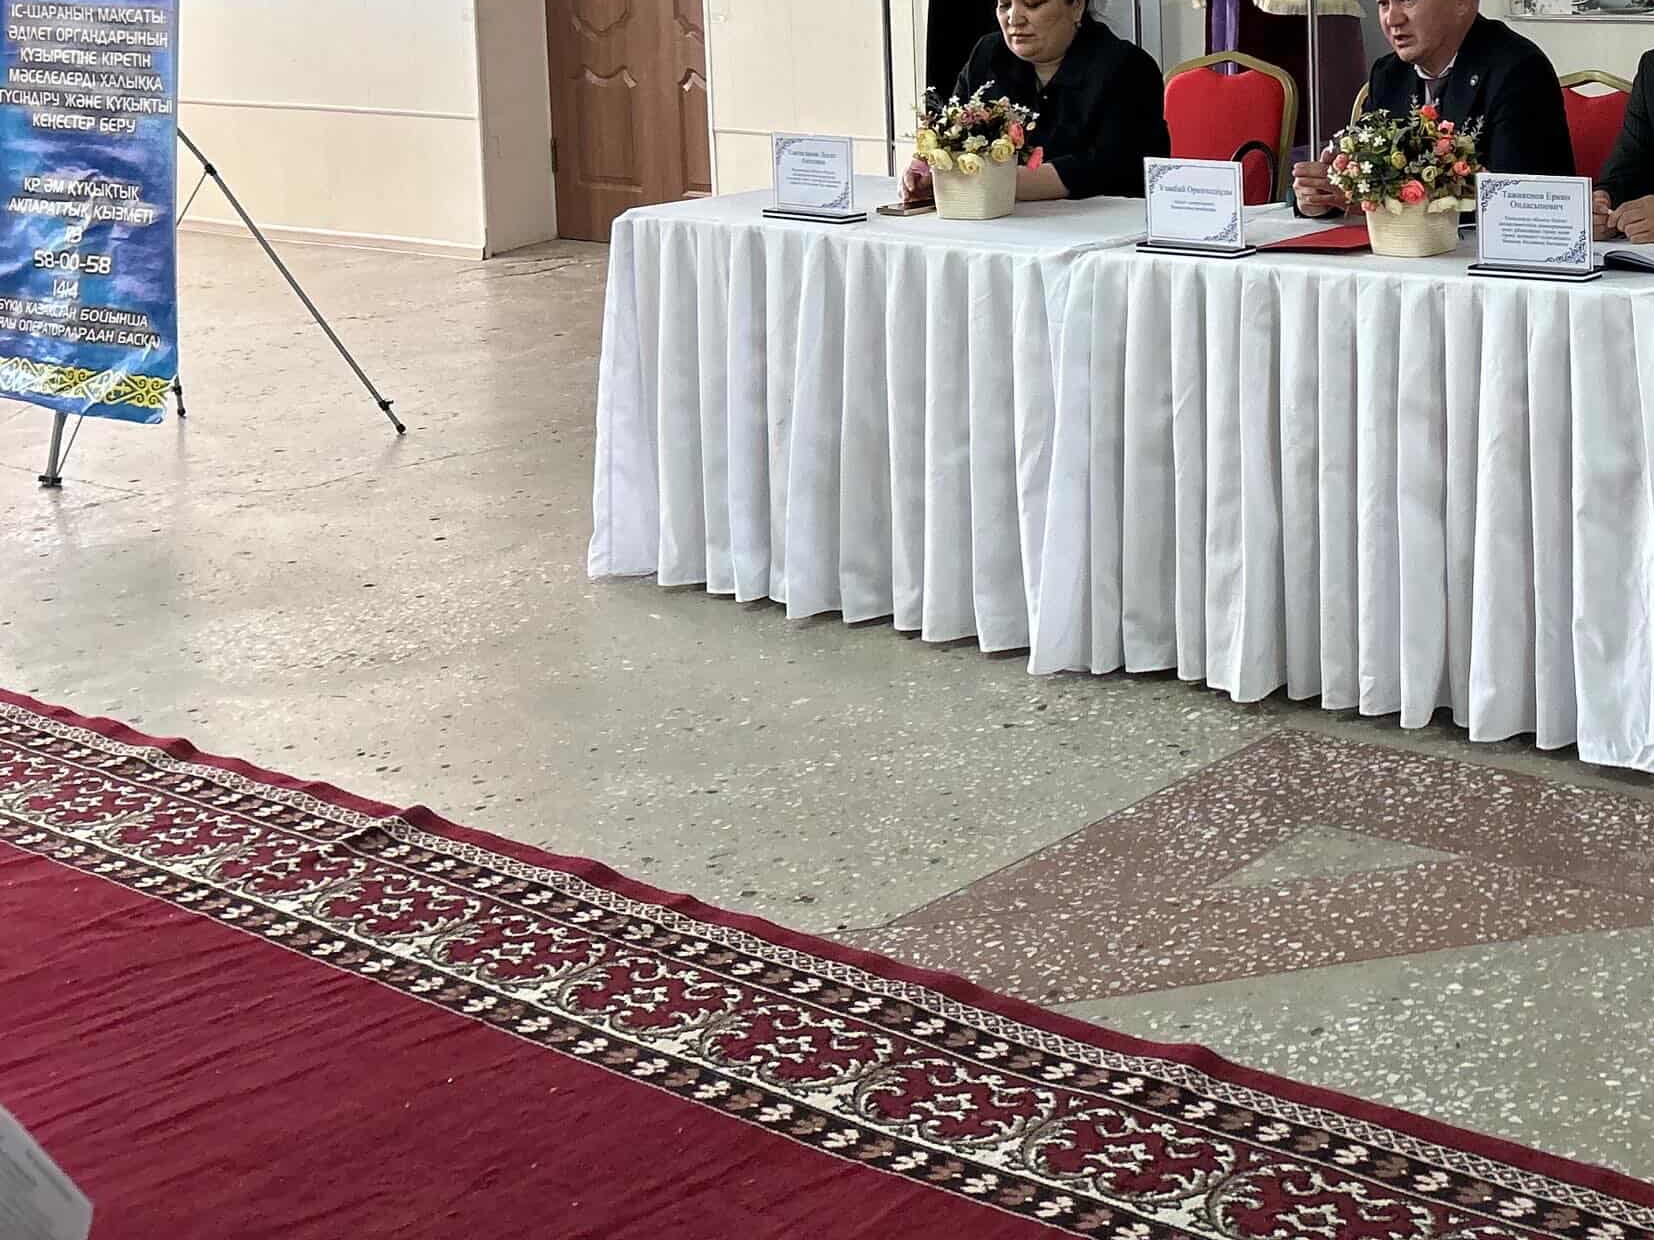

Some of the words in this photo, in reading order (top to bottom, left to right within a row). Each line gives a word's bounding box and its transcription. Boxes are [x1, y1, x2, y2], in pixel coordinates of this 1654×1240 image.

[100, 117, 137, 133] БЕРУ
[34, 250, 111, 274] 58-00-58
[80, 308, 149, 327] БОЙЫНША
